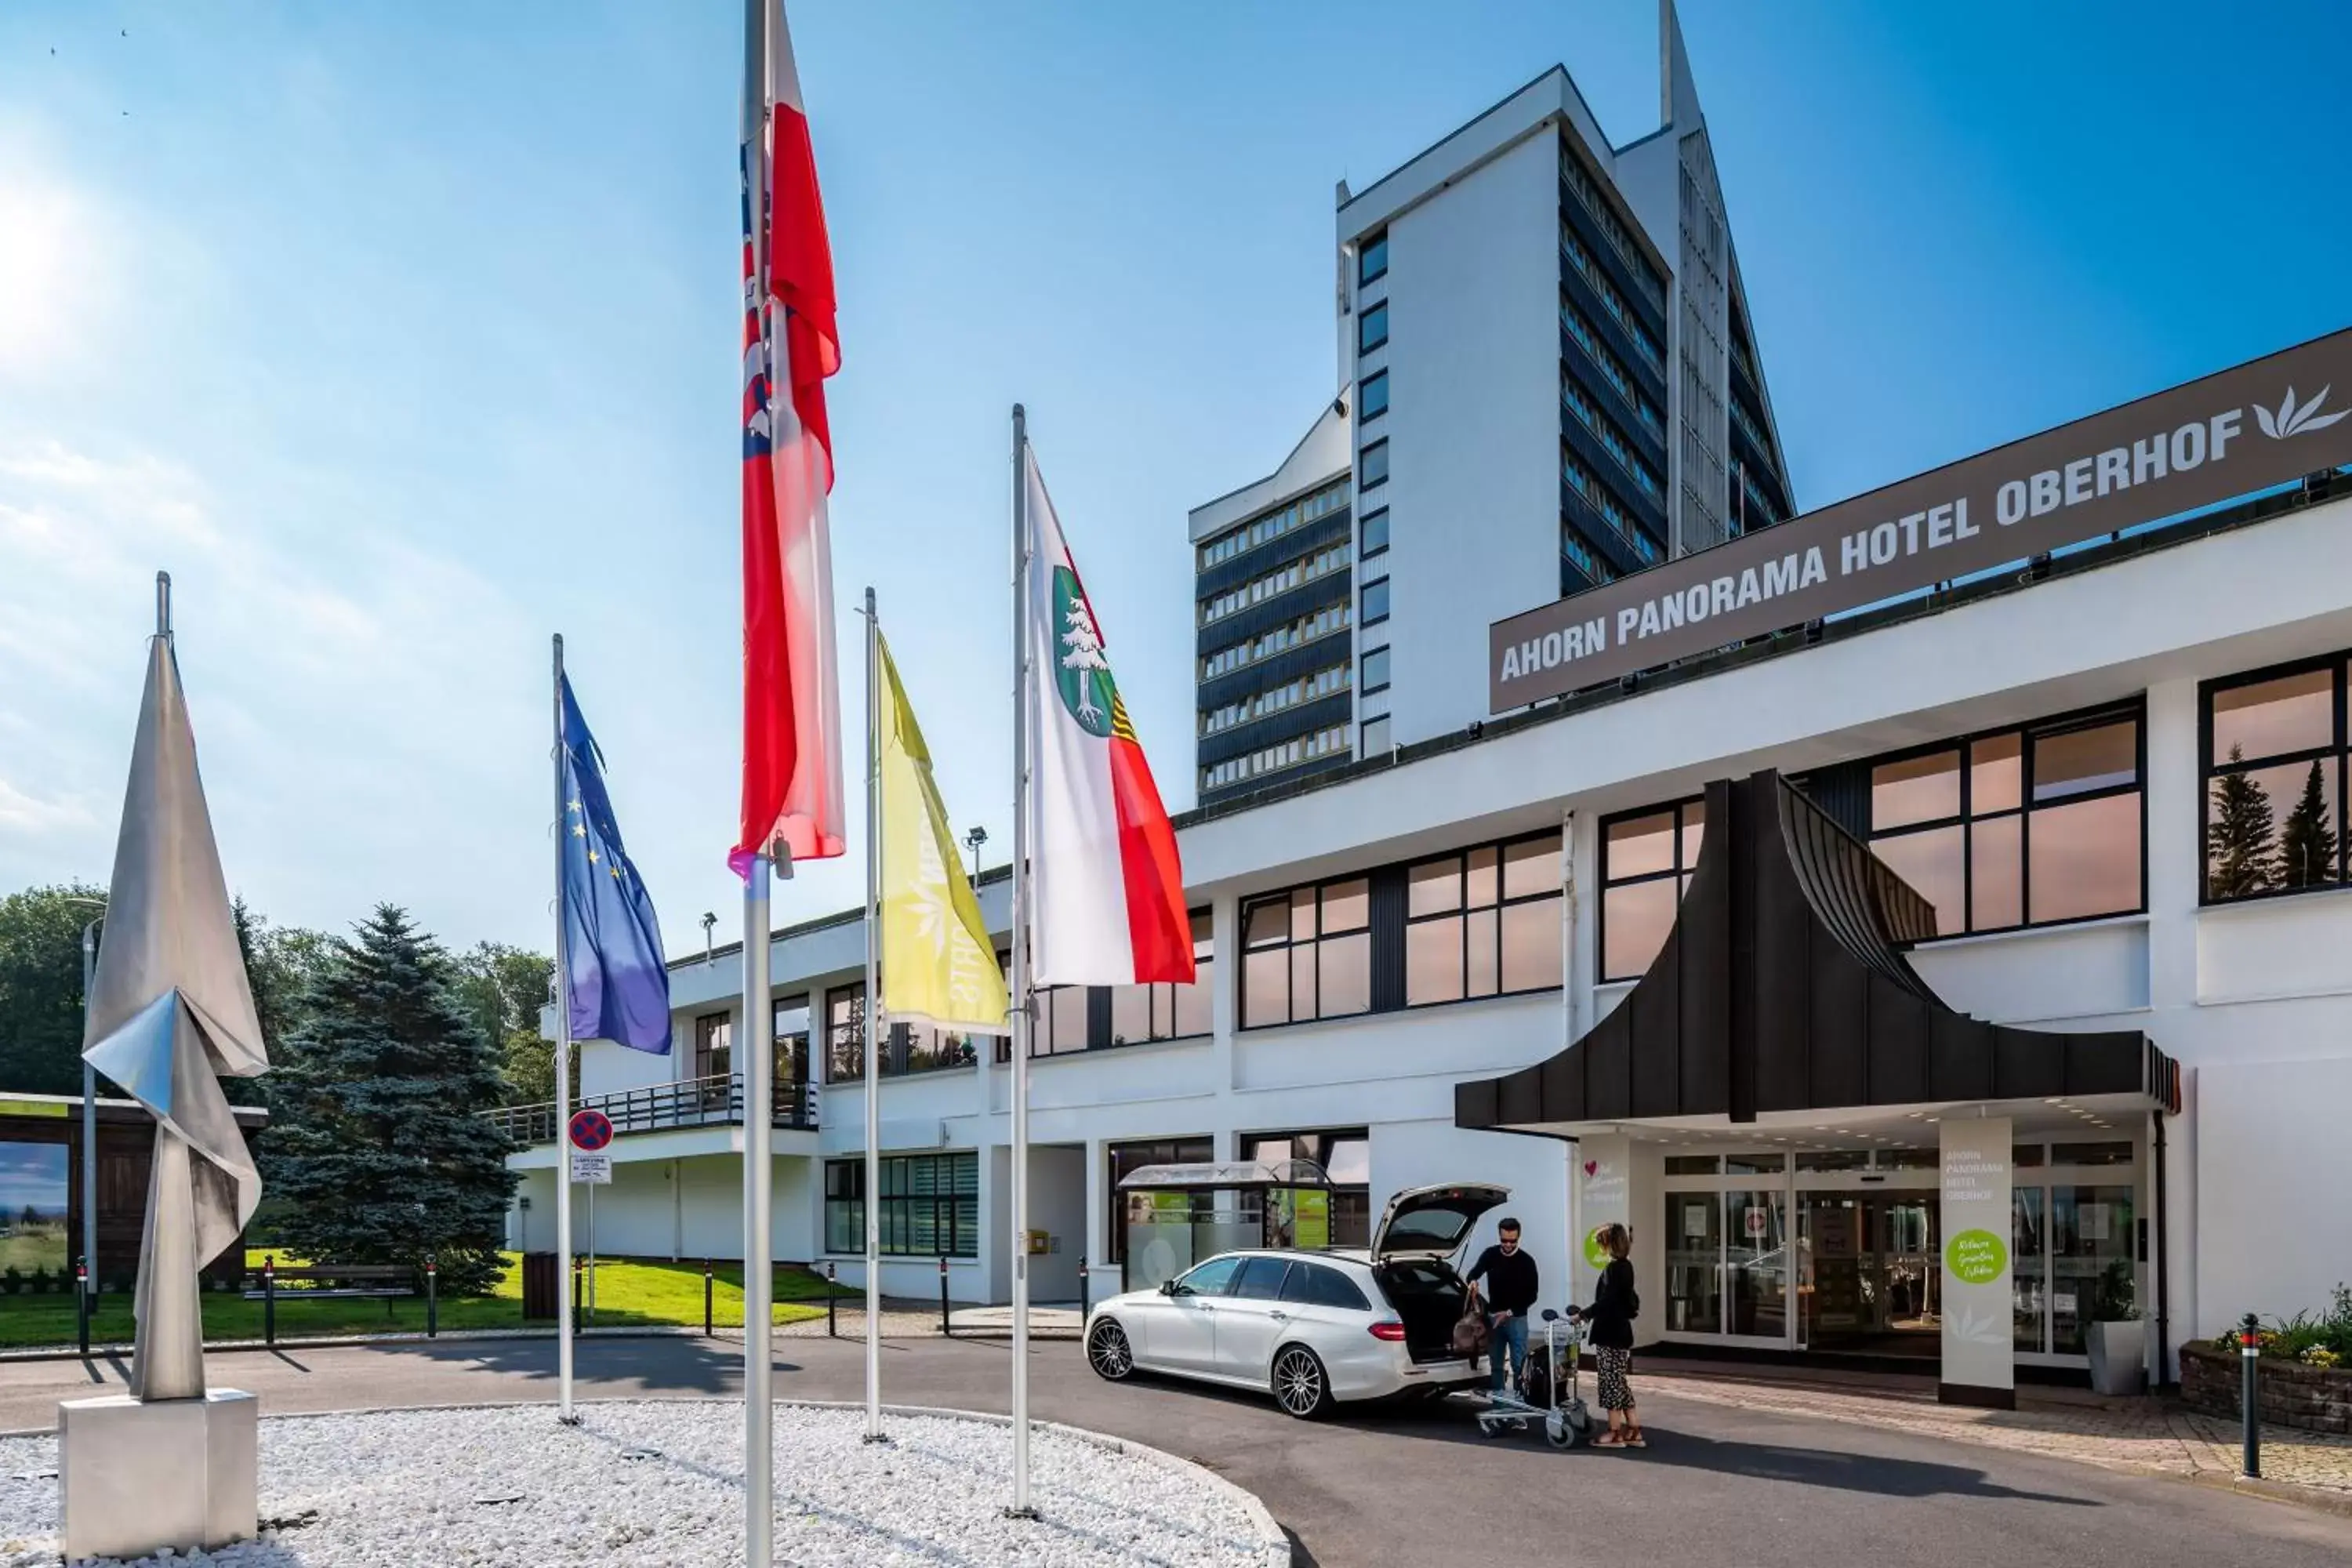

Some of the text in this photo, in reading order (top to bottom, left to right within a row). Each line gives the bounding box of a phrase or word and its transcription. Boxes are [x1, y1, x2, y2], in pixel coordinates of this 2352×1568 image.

[1501, 408, 2242, 682] AHORN PANORAMA HOTEL OBERHOF
